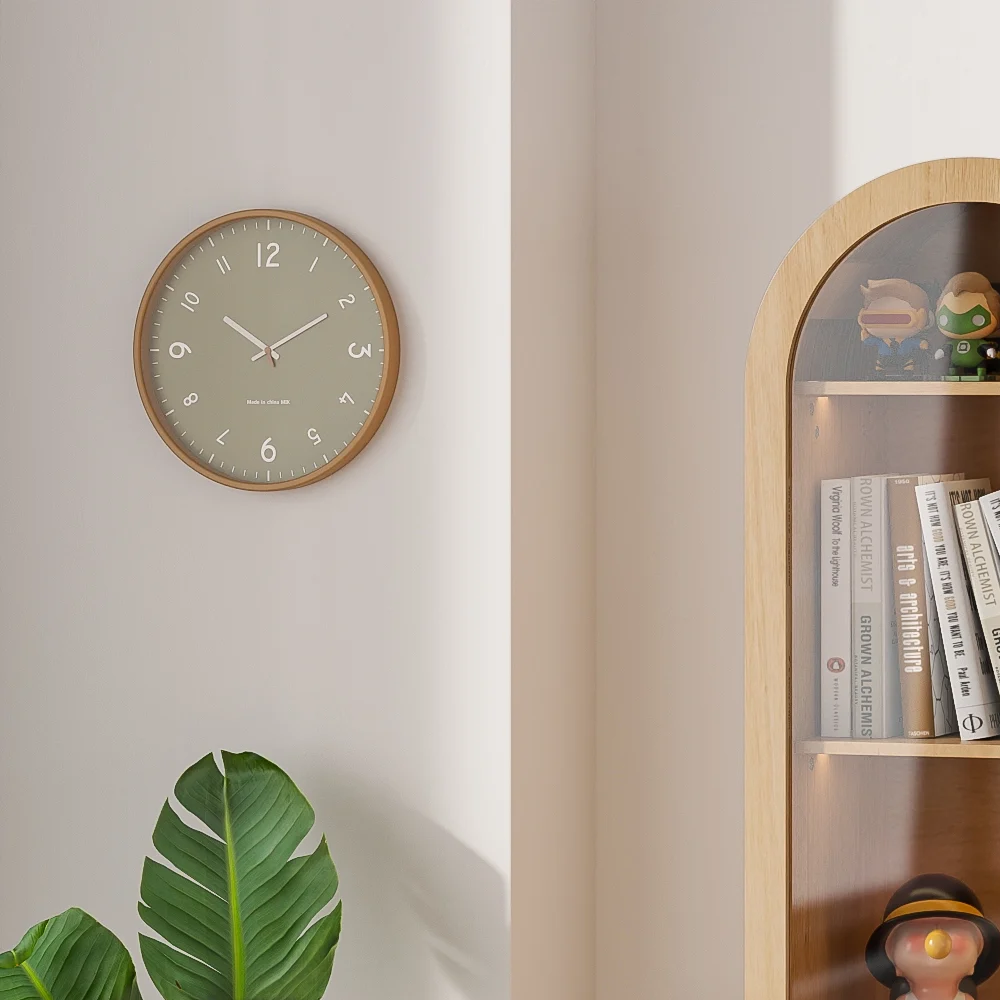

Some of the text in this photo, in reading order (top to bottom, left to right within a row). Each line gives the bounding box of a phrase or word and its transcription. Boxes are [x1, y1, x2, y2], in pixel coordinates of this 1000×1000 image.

[257, 242, 280, 268] 12
[181, 291, 200, 312] 10
[338, 294, 356, 309] 2
[169, 341, 192, 359] 9
[348, 342, 372, 359] 3
[183, 392, 199, 407] 8
[338, 391, 355, 405] 4
[216, 429, 230, 446] 7
[307, 427, 322, 446] 5
[260, 437, 277, 463] 6
[829, 486, 842, 513] Virginia
[924, 490, 937, 502] IT'S
[927, 503, 939, 514] NOT
[831, 514, 843, 535] Woolf
[929, 514, 942, 527] HOW
[860, 478, 873, 592] ROWN ALCHEMIST
[896, 545, 918, 571] arts
[934, 544, 947, 556] YOU
[960, 503, 980, 540] ROWN
[970, 543, 997, 606] ALCHEMIST
[946, 611, 959, 623] YOU
[899, 592, 924, 673] architecture
[949, 623, 962, 640] WANT
[952, 640, 964, 649] TO
[860, 615, 873, 739] GROWN ALCHEMIS
[957, 667, 968, 679] Paul
